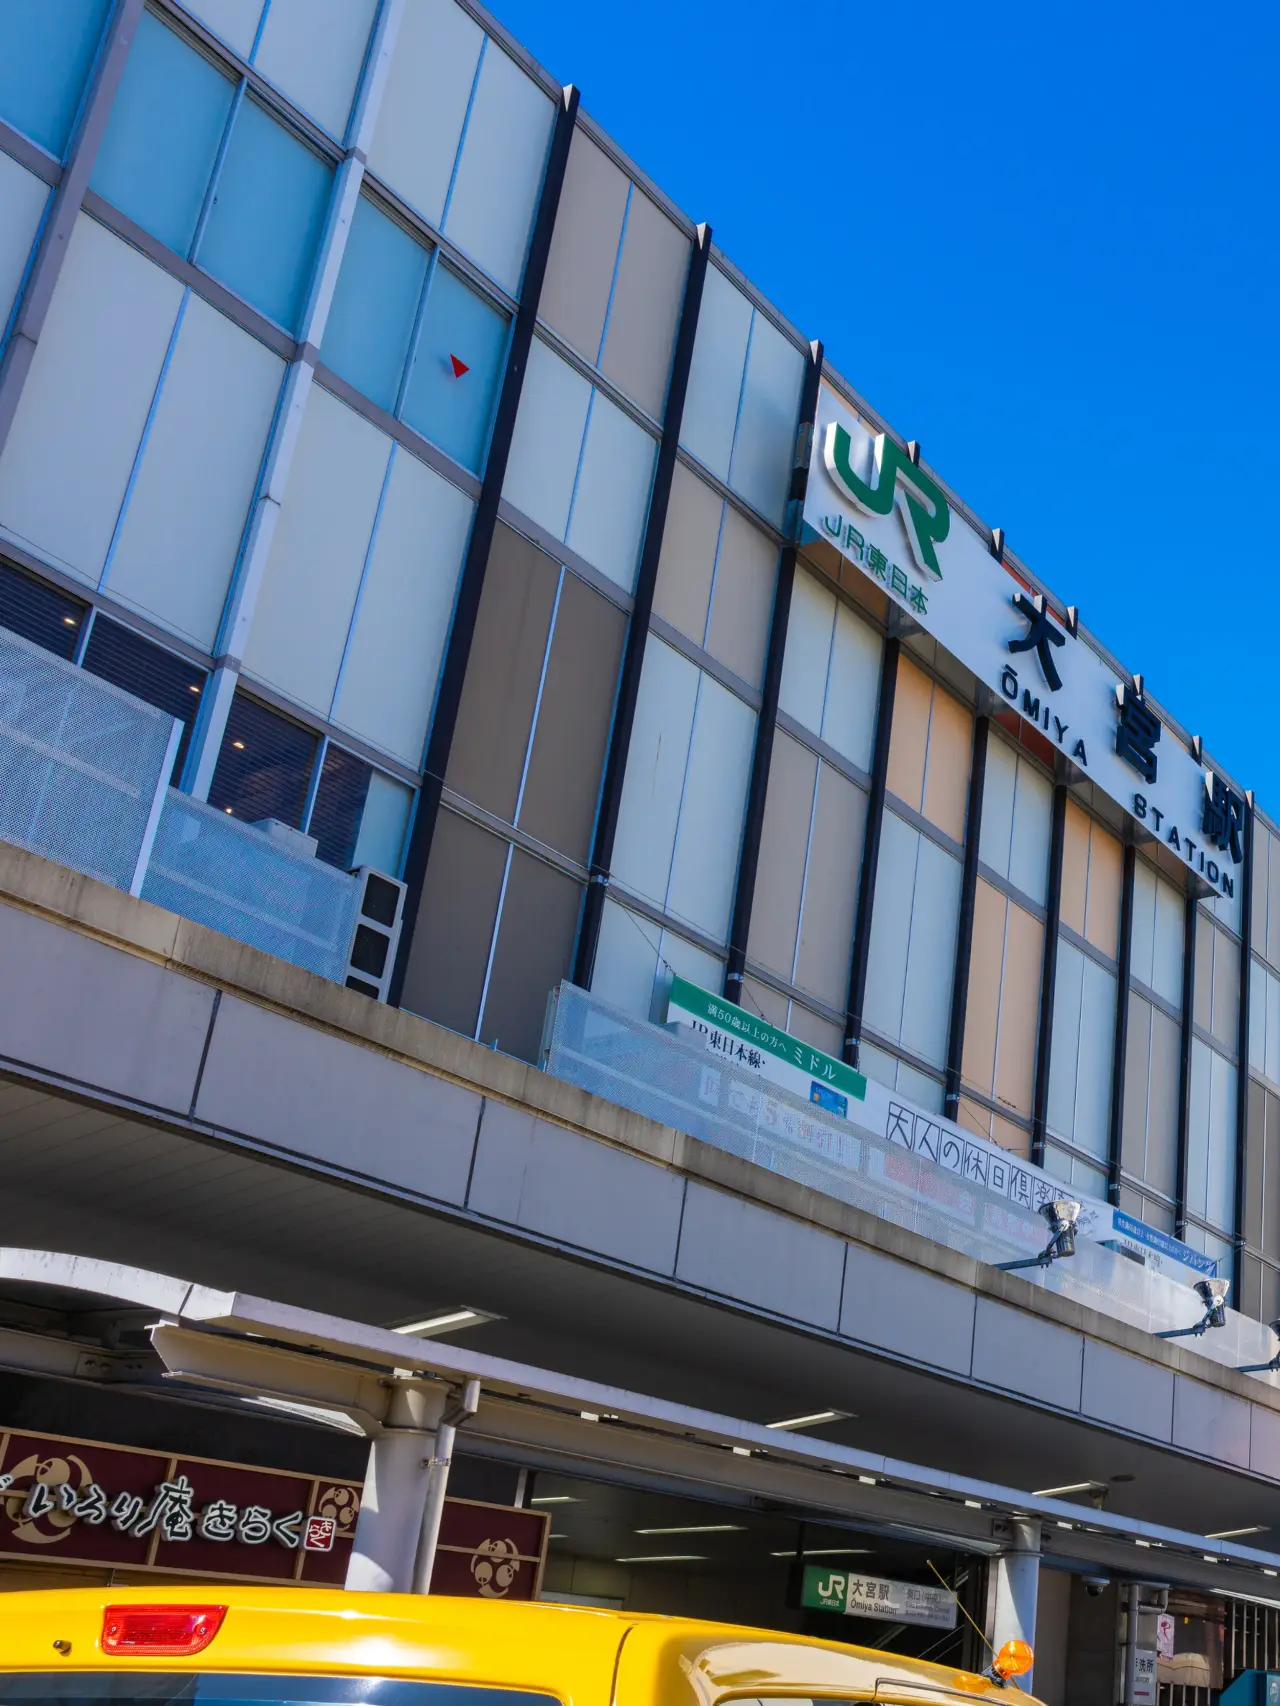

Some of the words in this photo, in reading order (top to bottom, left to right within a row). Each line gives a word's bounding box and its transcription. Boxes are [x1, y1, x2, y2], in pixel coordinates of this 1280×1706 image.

[825, 421, 950, 582] JR
[825, 514, 929, 616] JR東日本
[1008, 593, 1245, 865] 大宮駅
[1133, 792, 1234, 898] STATION
[707, 1003, 787, 1053] 満50歳以上の方へ
[792, 1046, 837, 1081] ミドル
[817, 1574, 846, 1600] JR
[850, 1599, 873, 1613] Ōmiya
[873, 1602, 897, 1616] Station
[852, 1579, 890, 1601] 大宮駅
